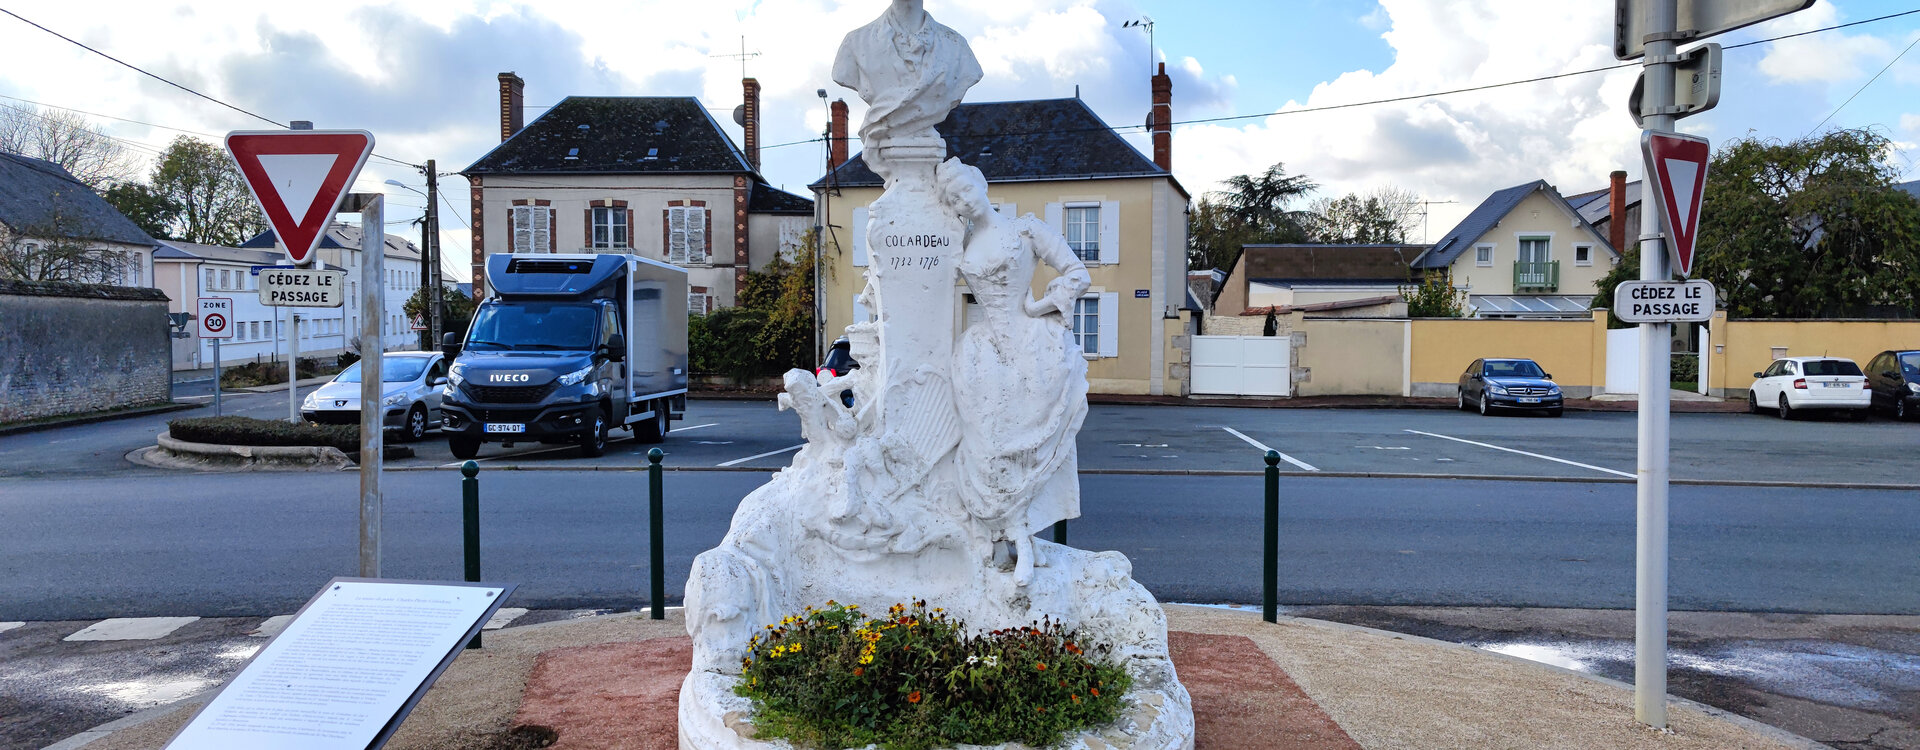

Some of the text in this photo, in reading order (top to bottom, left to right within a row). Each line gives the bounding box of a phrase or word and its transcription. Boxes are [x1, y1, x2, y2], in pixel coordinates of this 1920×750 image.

[885, 234, 949, 248] COLARDEAU
[919, 255, 940, 270] 1776
[268, 272, 332, 286] CÉDEZ LE
[271, 291, 329, 302] PASSAGE
[1632, 285, 1701, 299] CÉDEZ LE
[1633, 303, 1699, 315] PASSAGE
[208, 318, 222, 327] 30
[489, 374, 529, 382] IVECO
